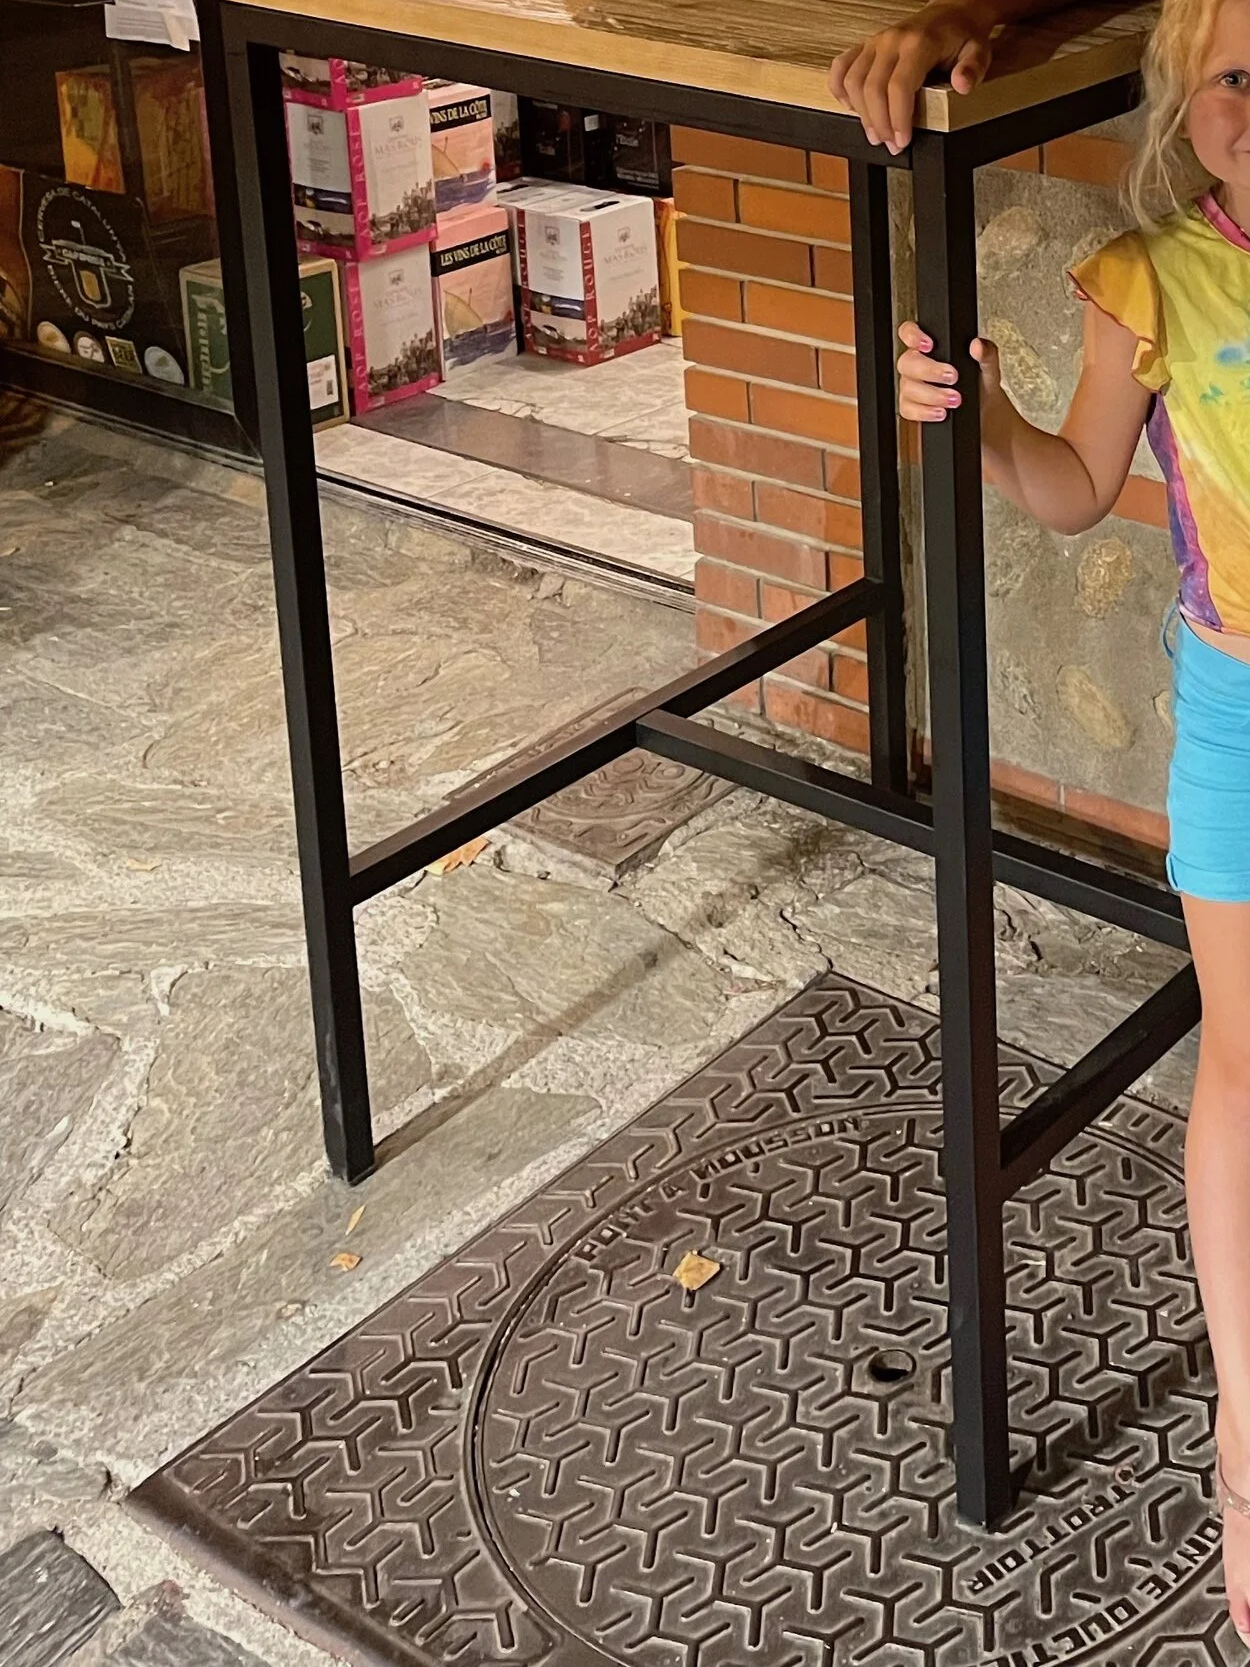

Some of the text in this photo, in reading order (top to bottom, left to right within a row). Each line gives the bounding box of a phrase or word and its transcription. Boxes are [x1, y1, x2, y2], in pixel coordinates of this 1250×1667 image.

[571, 1198, 654, 1262] PONT
[691, 1116, 864, 1182] MOUSSON
[965, 1484, 1136, 1596] TROTTOIR
[967, 1514, 1224, 1667] ONTE DUCTI
